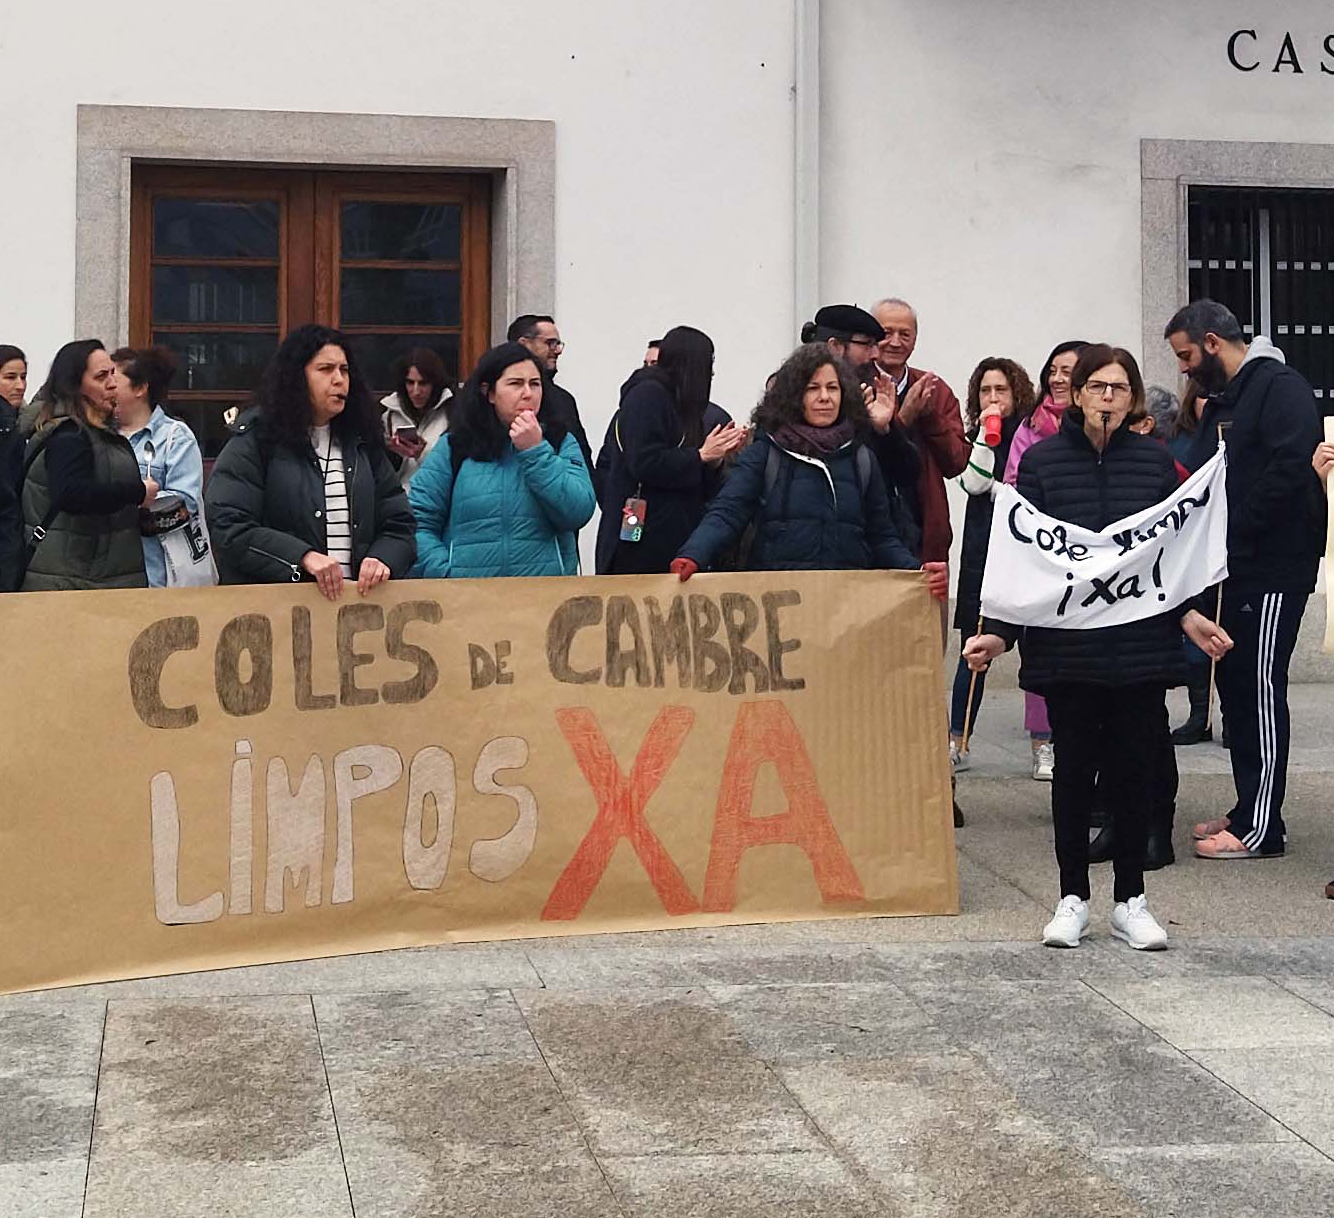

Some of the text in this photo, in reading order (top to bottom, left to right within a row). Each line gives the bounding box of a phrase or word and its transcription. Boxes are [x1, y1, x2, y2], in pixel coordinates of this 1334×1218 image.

[128, 589, 805, 729] COLES DE CAMBRE
[540, 700, 865, 922] XA
